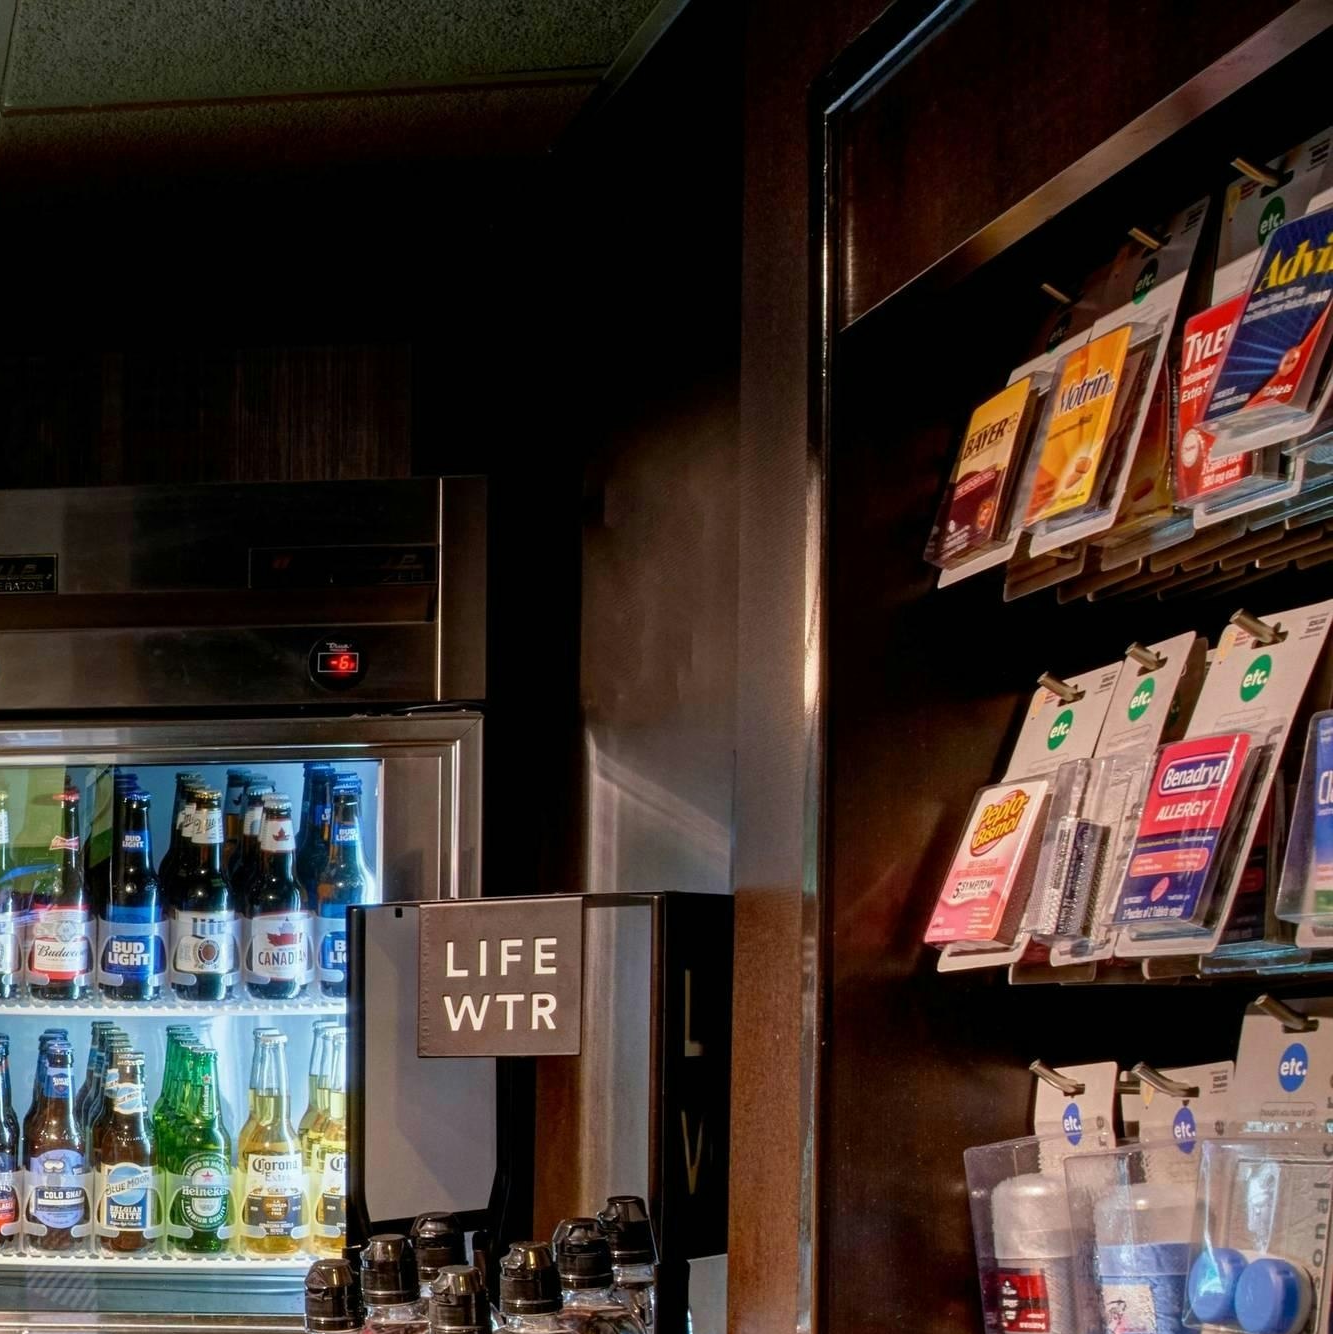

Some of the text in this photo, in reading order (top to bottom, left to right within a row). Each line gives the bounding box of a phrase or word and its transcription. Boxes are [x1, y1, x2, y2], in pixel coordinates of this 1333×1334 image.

[1259, 212, 1286, 233] etc.
[1254, 232, 1333, 294] Advi
[1059, 370, 1108, 416] Motrin
[964, 418, 1006, 462] BAYER
[1242, 670, 1268, 689] etc.
[1129, 691, 1152, 708] etc.
[1050, 721, 1071, 738] etc.
[1162, 760, 1226, 790] Benadryl
[1155, 800, 1212, 822] ALLERGY
[973, 817, 1020, 850] Bismol
[111, 940, 145, 955] BUD
[445, 937, 558, 978] LIFE
[107, 952, 151, 967] LIGHT
[443, 993, 558, 1033] WTR
[1278, 1059, 1307, 1077] etc.
[1063, 1115, 1082, 1132] etc.
[1174, 1122, 1196, 1139] etc.
[252, 1157, 299, 1175] Corona
[105, 1175, 151, 1197] BLUE MOON
[109, 1211, 142, 1220] WHITE
